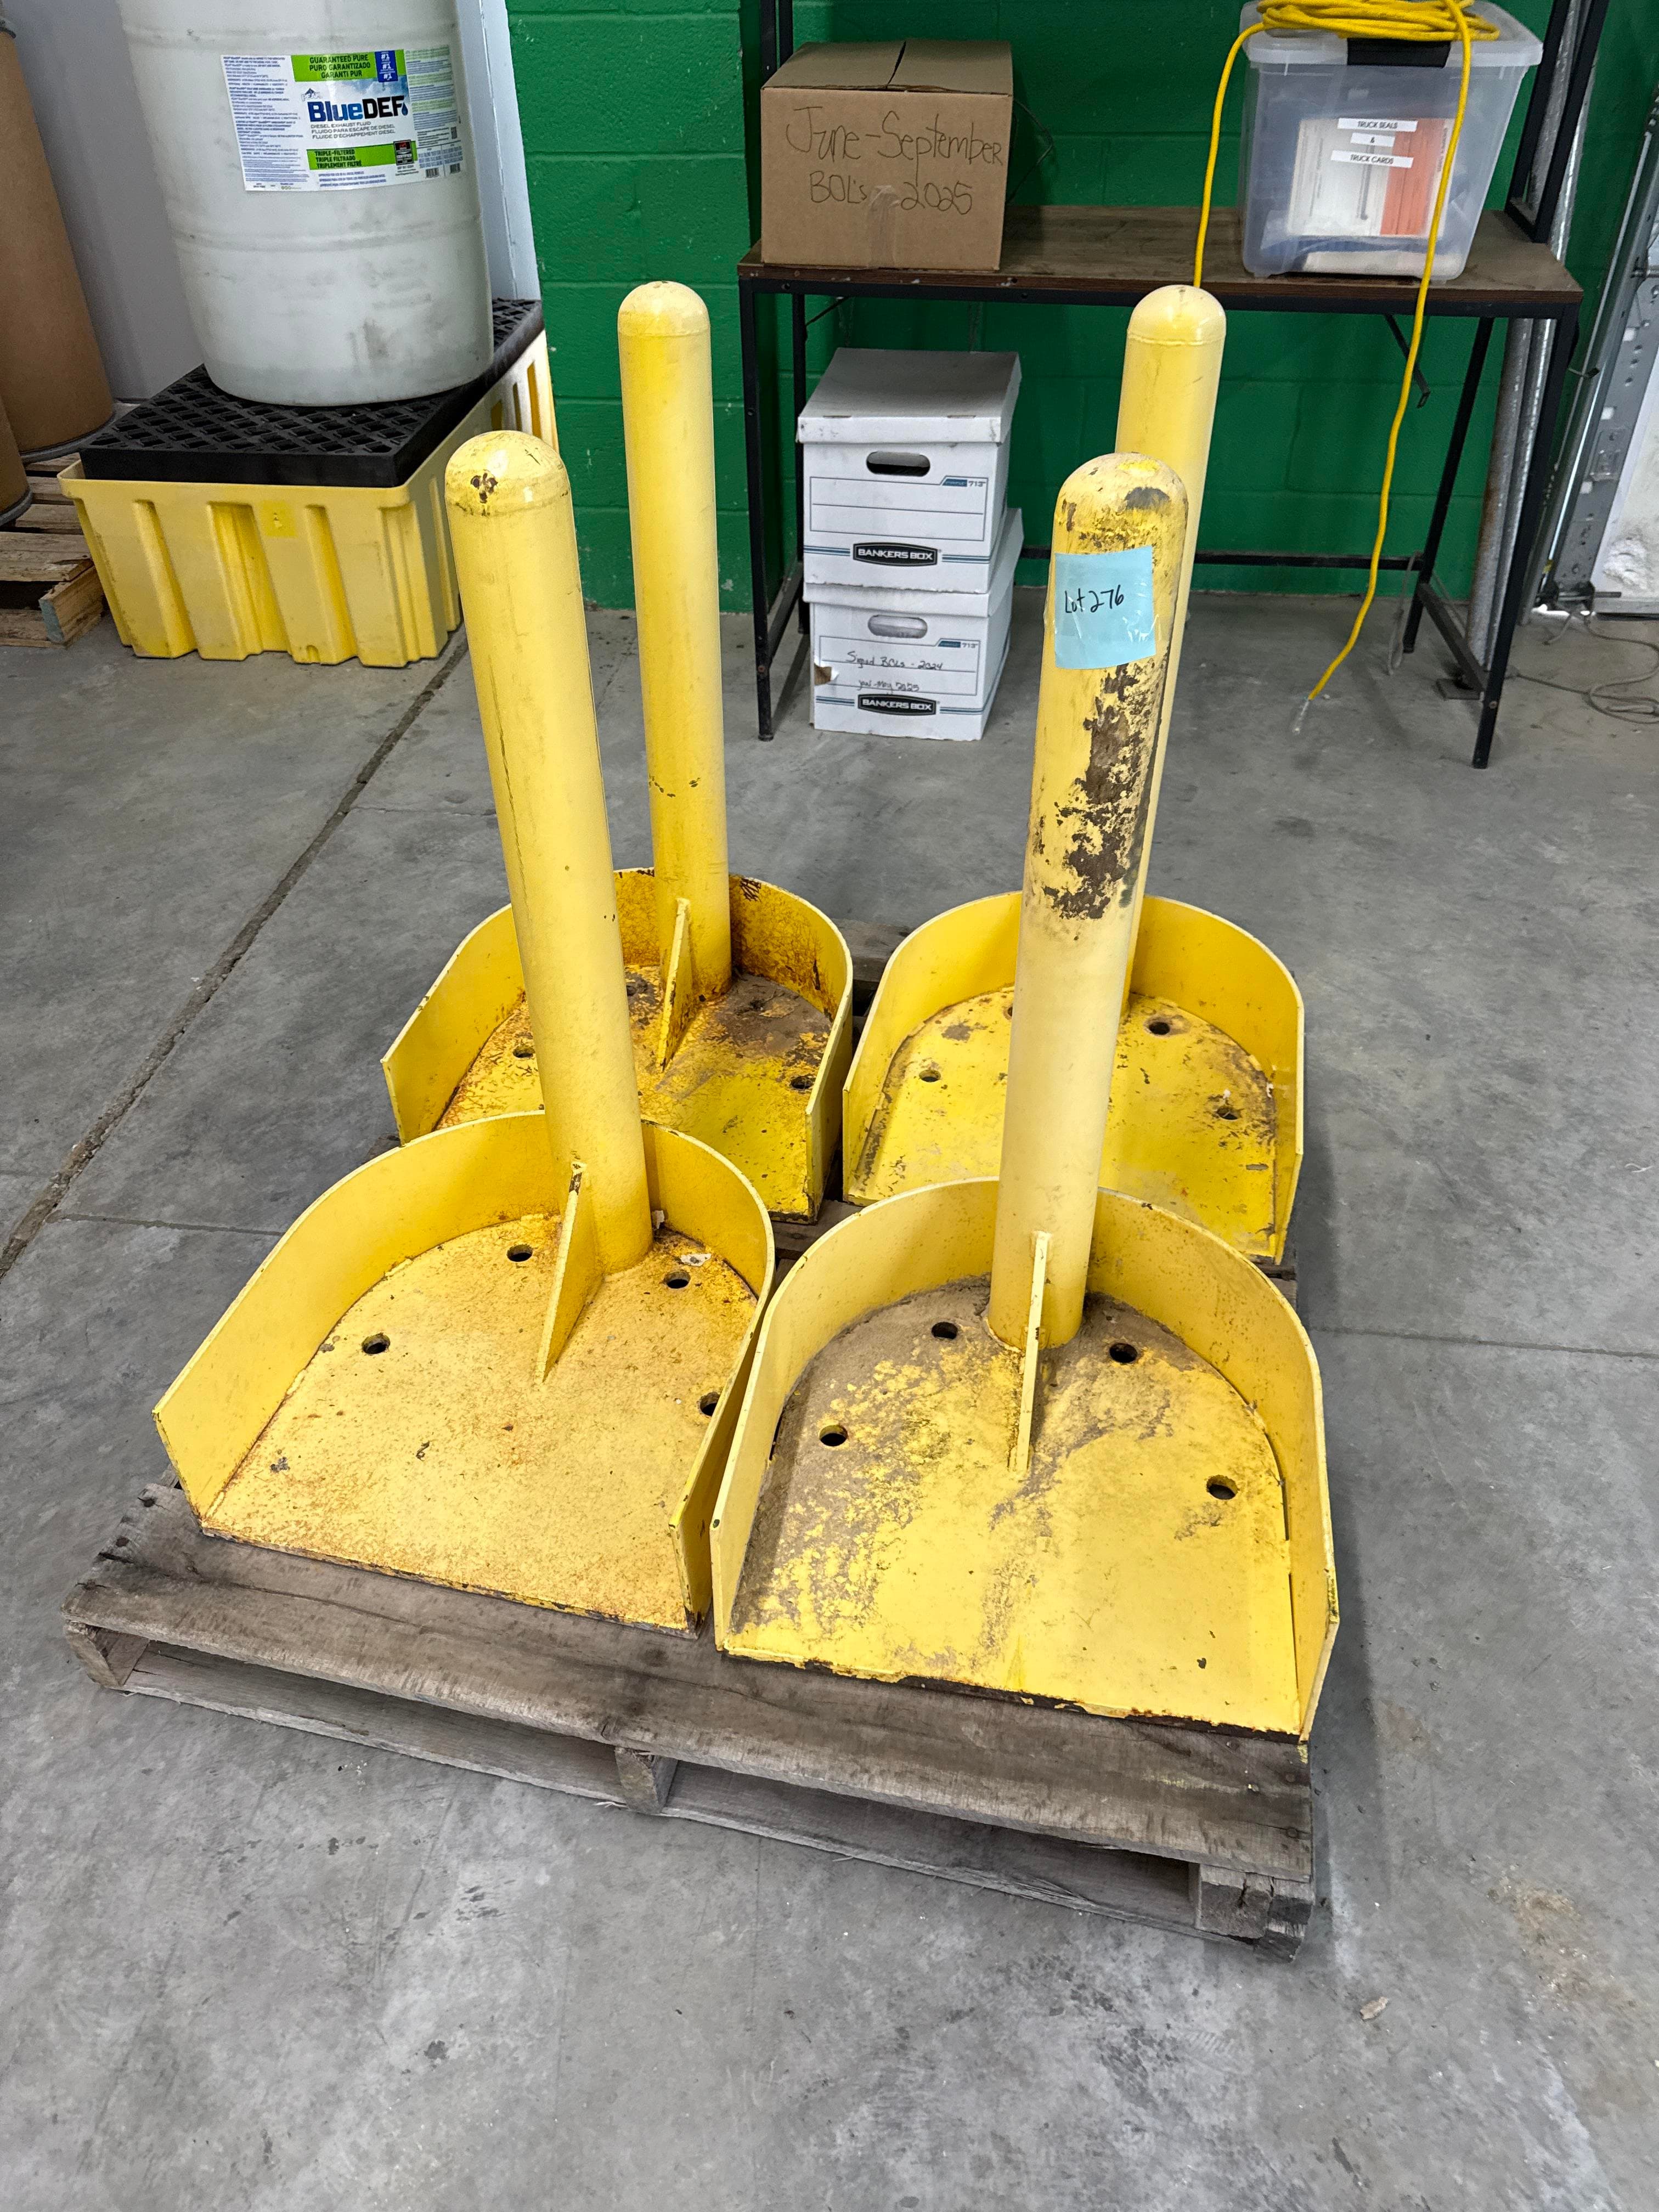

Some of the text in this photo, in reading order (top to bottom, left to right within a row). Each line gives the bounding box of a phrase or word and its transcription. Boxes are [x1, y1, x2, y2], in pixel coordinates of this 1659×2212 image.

[309, 55, 351, 64] GUARANTEED
[329, 62, 370, 70] GARANTIZADO
[307, 95, 404, 122] BlueDEF
[1350, 154, 1394, 164] TRUCK CARDS
[900, 180, 973, 215] 2025
[857, 549, 933, 561] BANKERS BOX
[1065, 584, 1125, 613] Lot 276
[918, 660, 943, 670] 2024
[862, 698, 932, 712] BANKERS BOX
